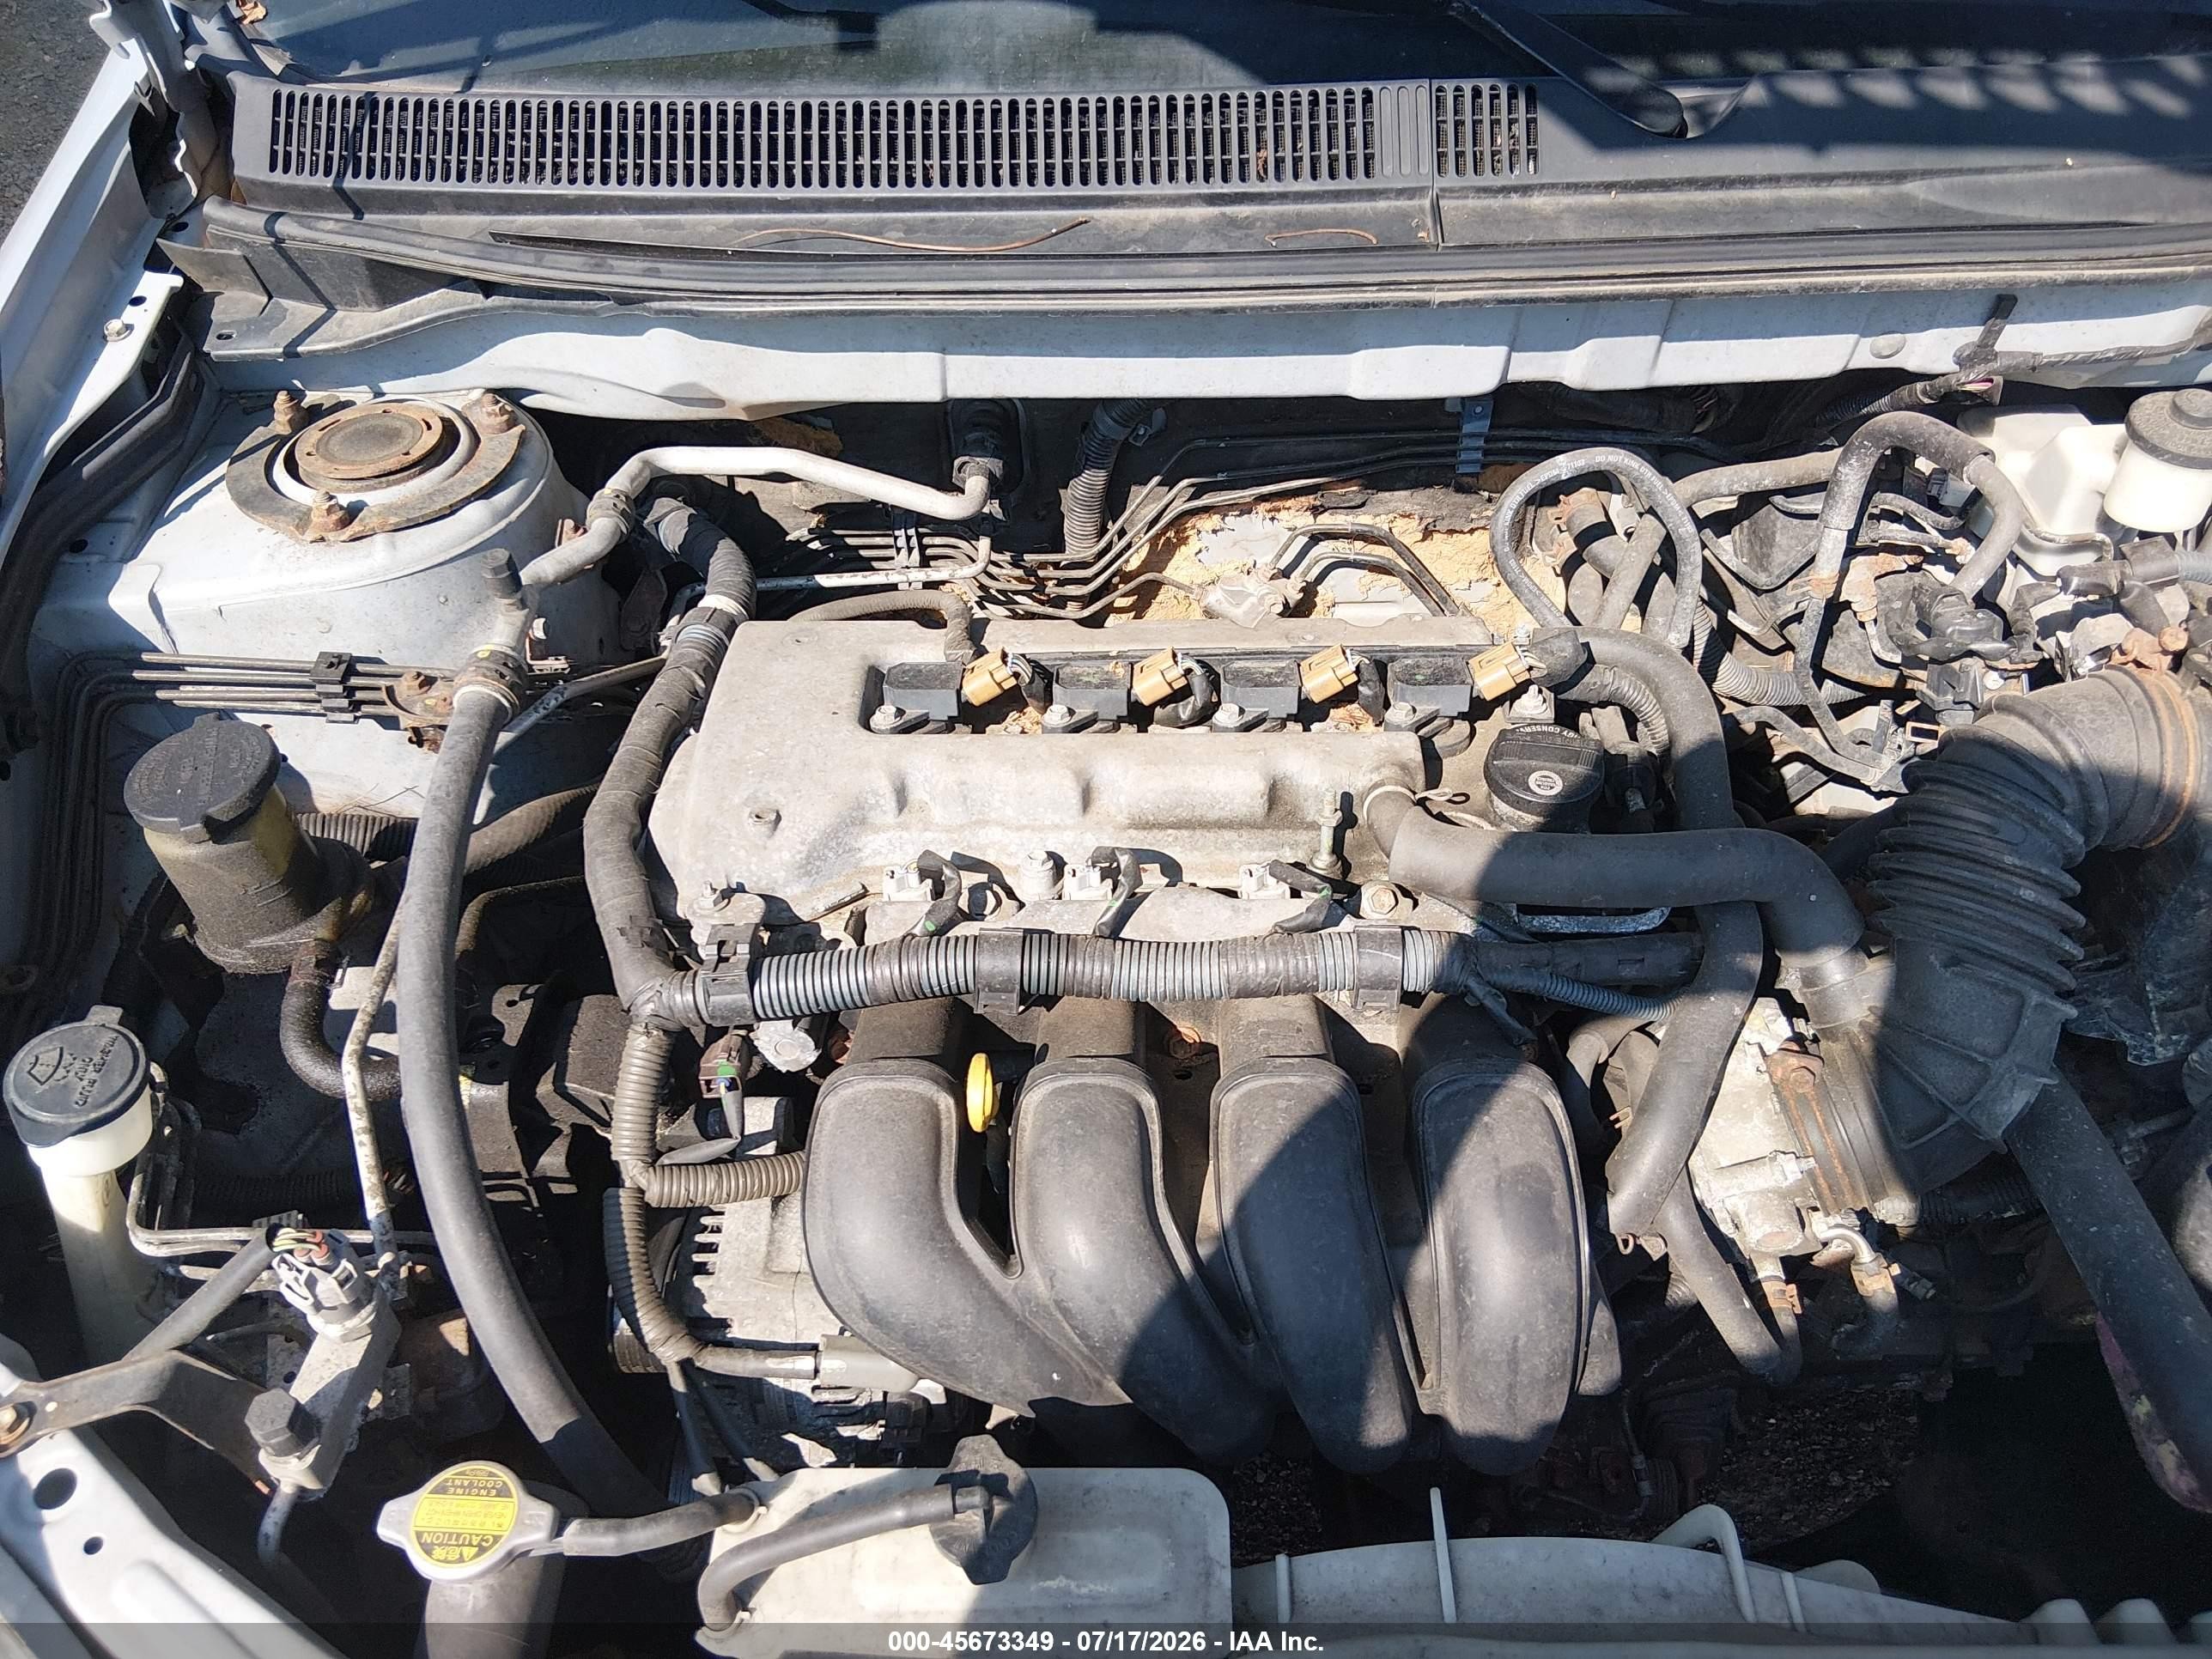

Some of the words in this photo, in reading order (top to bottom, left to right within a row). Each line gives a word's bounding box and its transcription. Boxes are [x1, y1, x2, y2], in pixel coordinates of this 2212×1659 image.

[1607, 454, 1622, 463] NOT
[1650, 475, 1664, 489] FUEL
[447, 1479, 502, 1487] COOLANT
[447, 1487, 497, 1496] ENGINE
[422, 1532, 494, 1547] CAUTION
